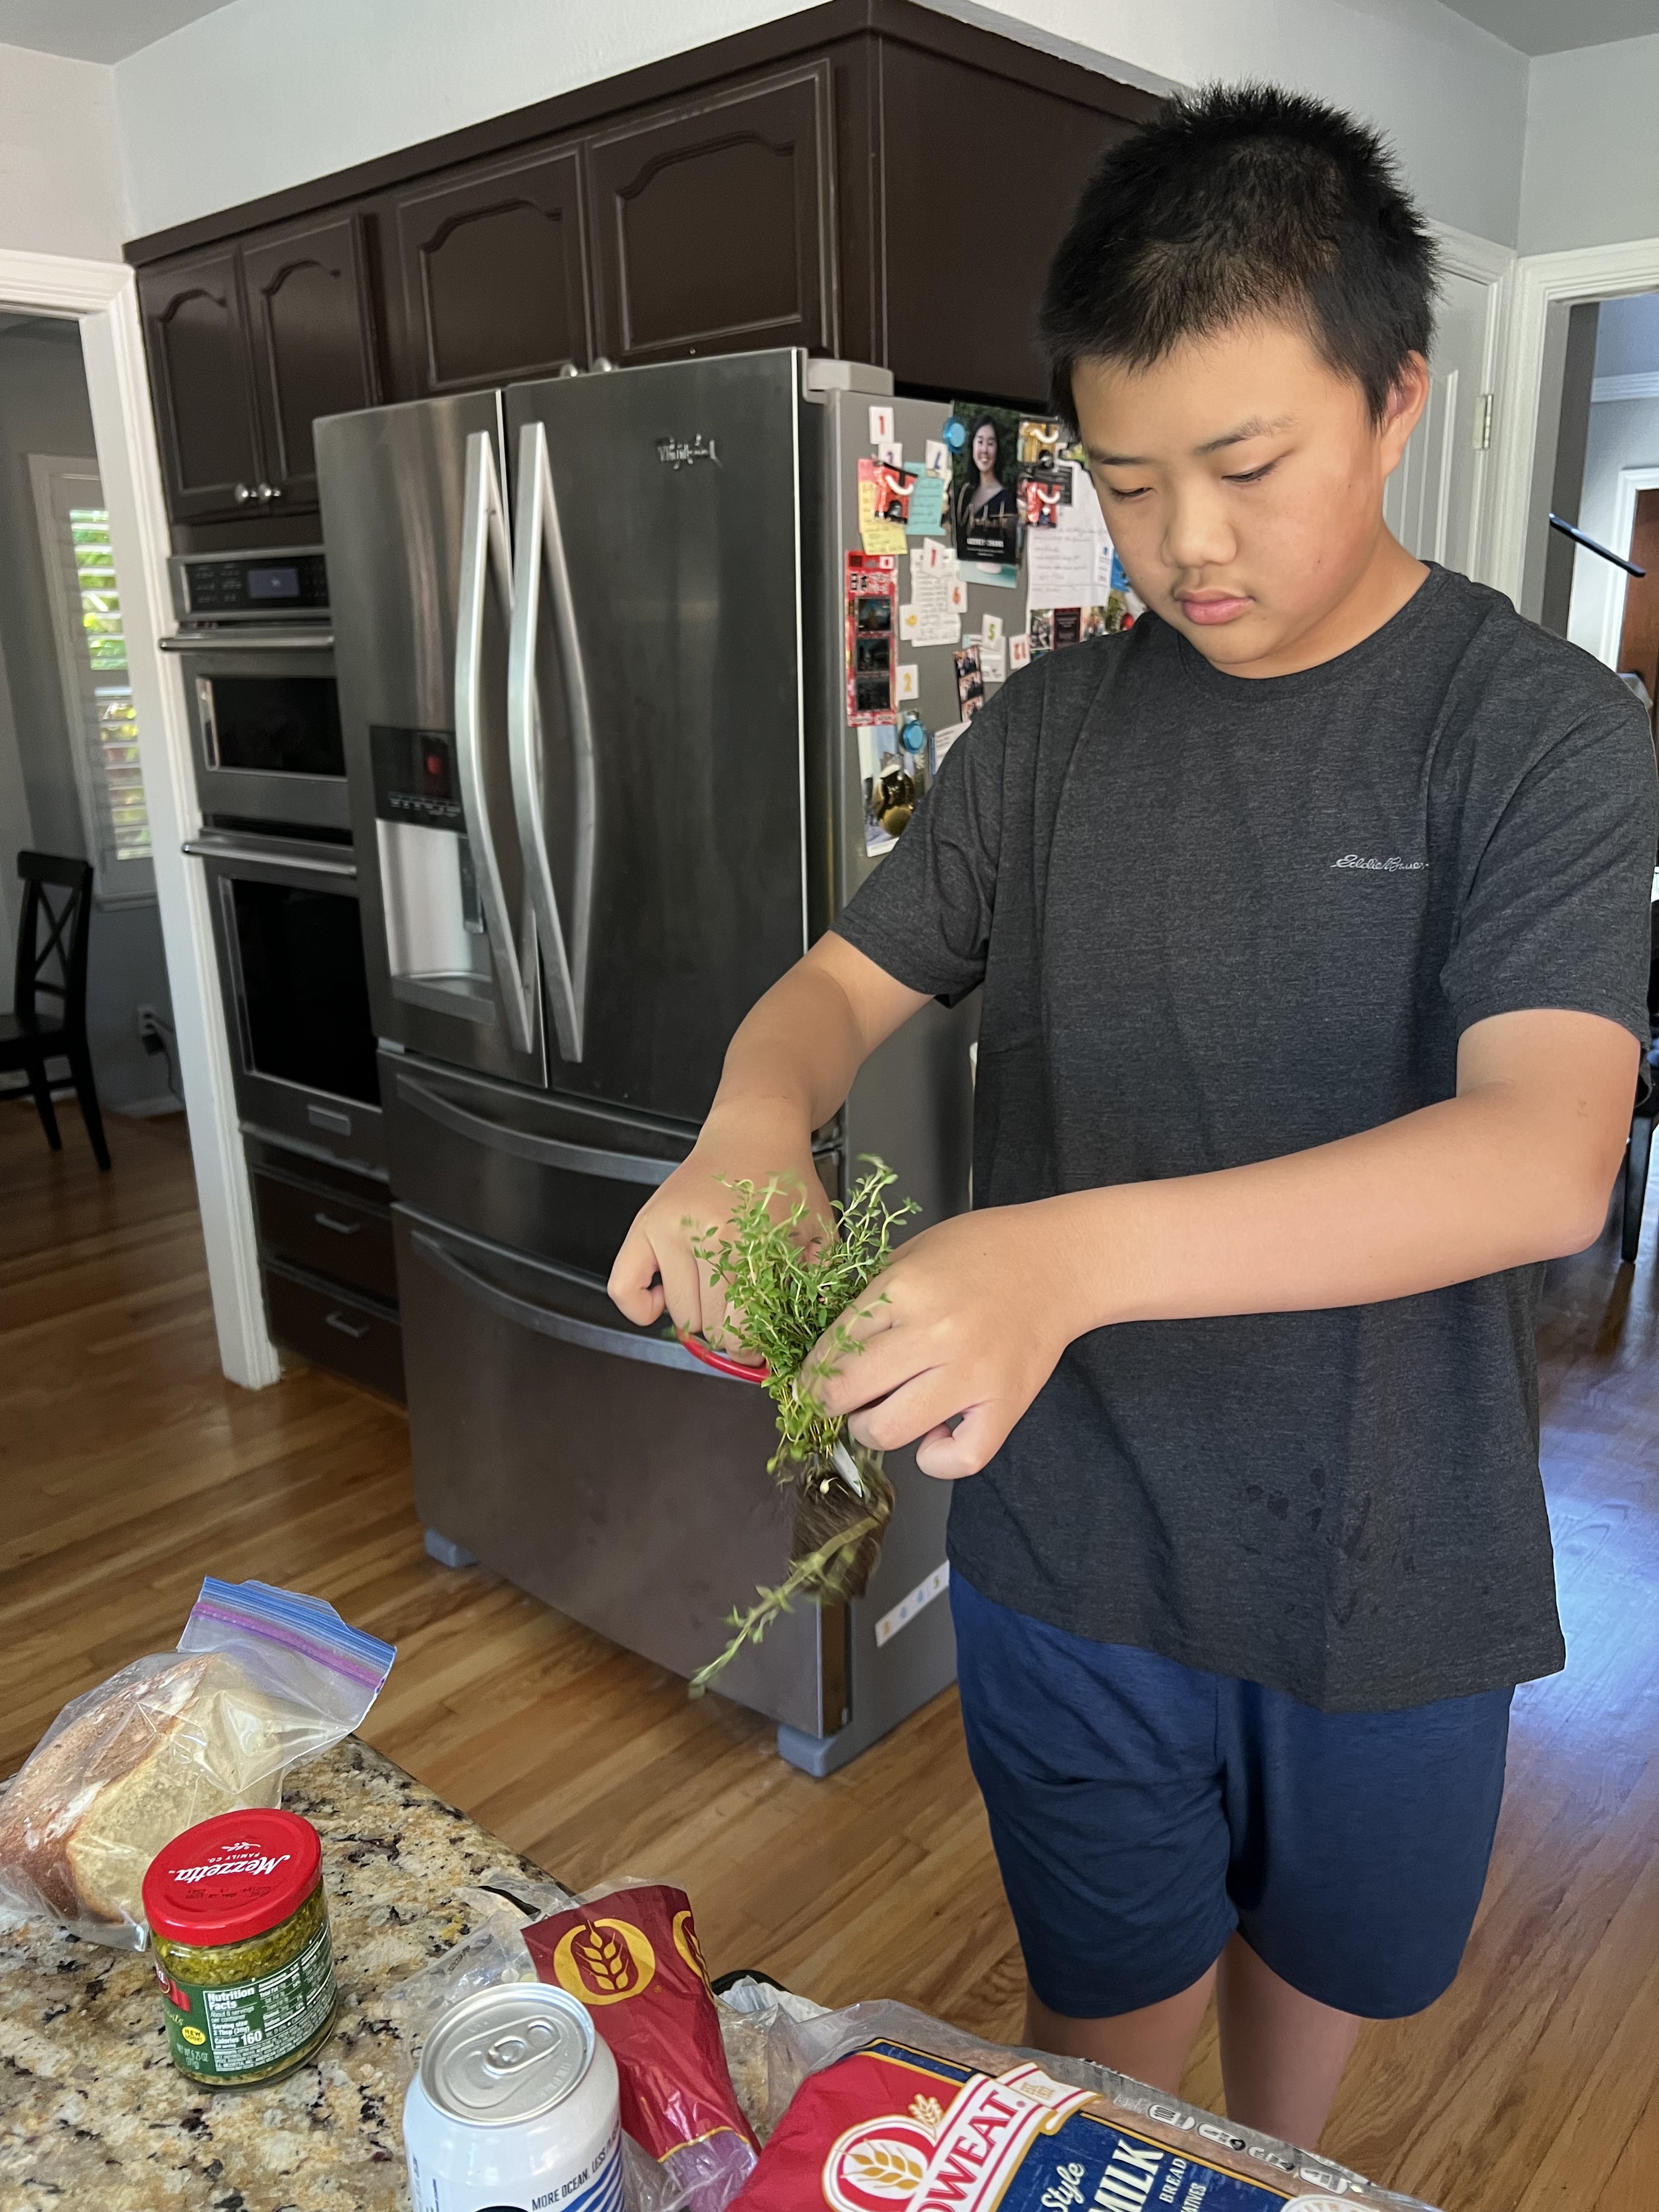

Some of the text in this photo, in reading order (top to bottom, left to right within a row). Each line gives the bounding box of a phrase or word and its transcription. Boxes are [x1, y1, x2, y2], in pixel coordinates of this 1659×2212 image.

[174, 1854, 291, 1884] Mezzetta
[225, 1852, 261, 1861] FAMILY
[207, 1987, 255, 2002] Nutrition
[208, 2000, 238, 2011] Facts
[240, 2030, 262, 2046] 160
[916, 2090, 1018, 2212] WEAT
[532, 2147, 606, 2211] MORE OCEAN. LESS
[1159, 2158, 1187, 2204] BREAD
[1181, 2183, 1206, 2212] ATIVES
